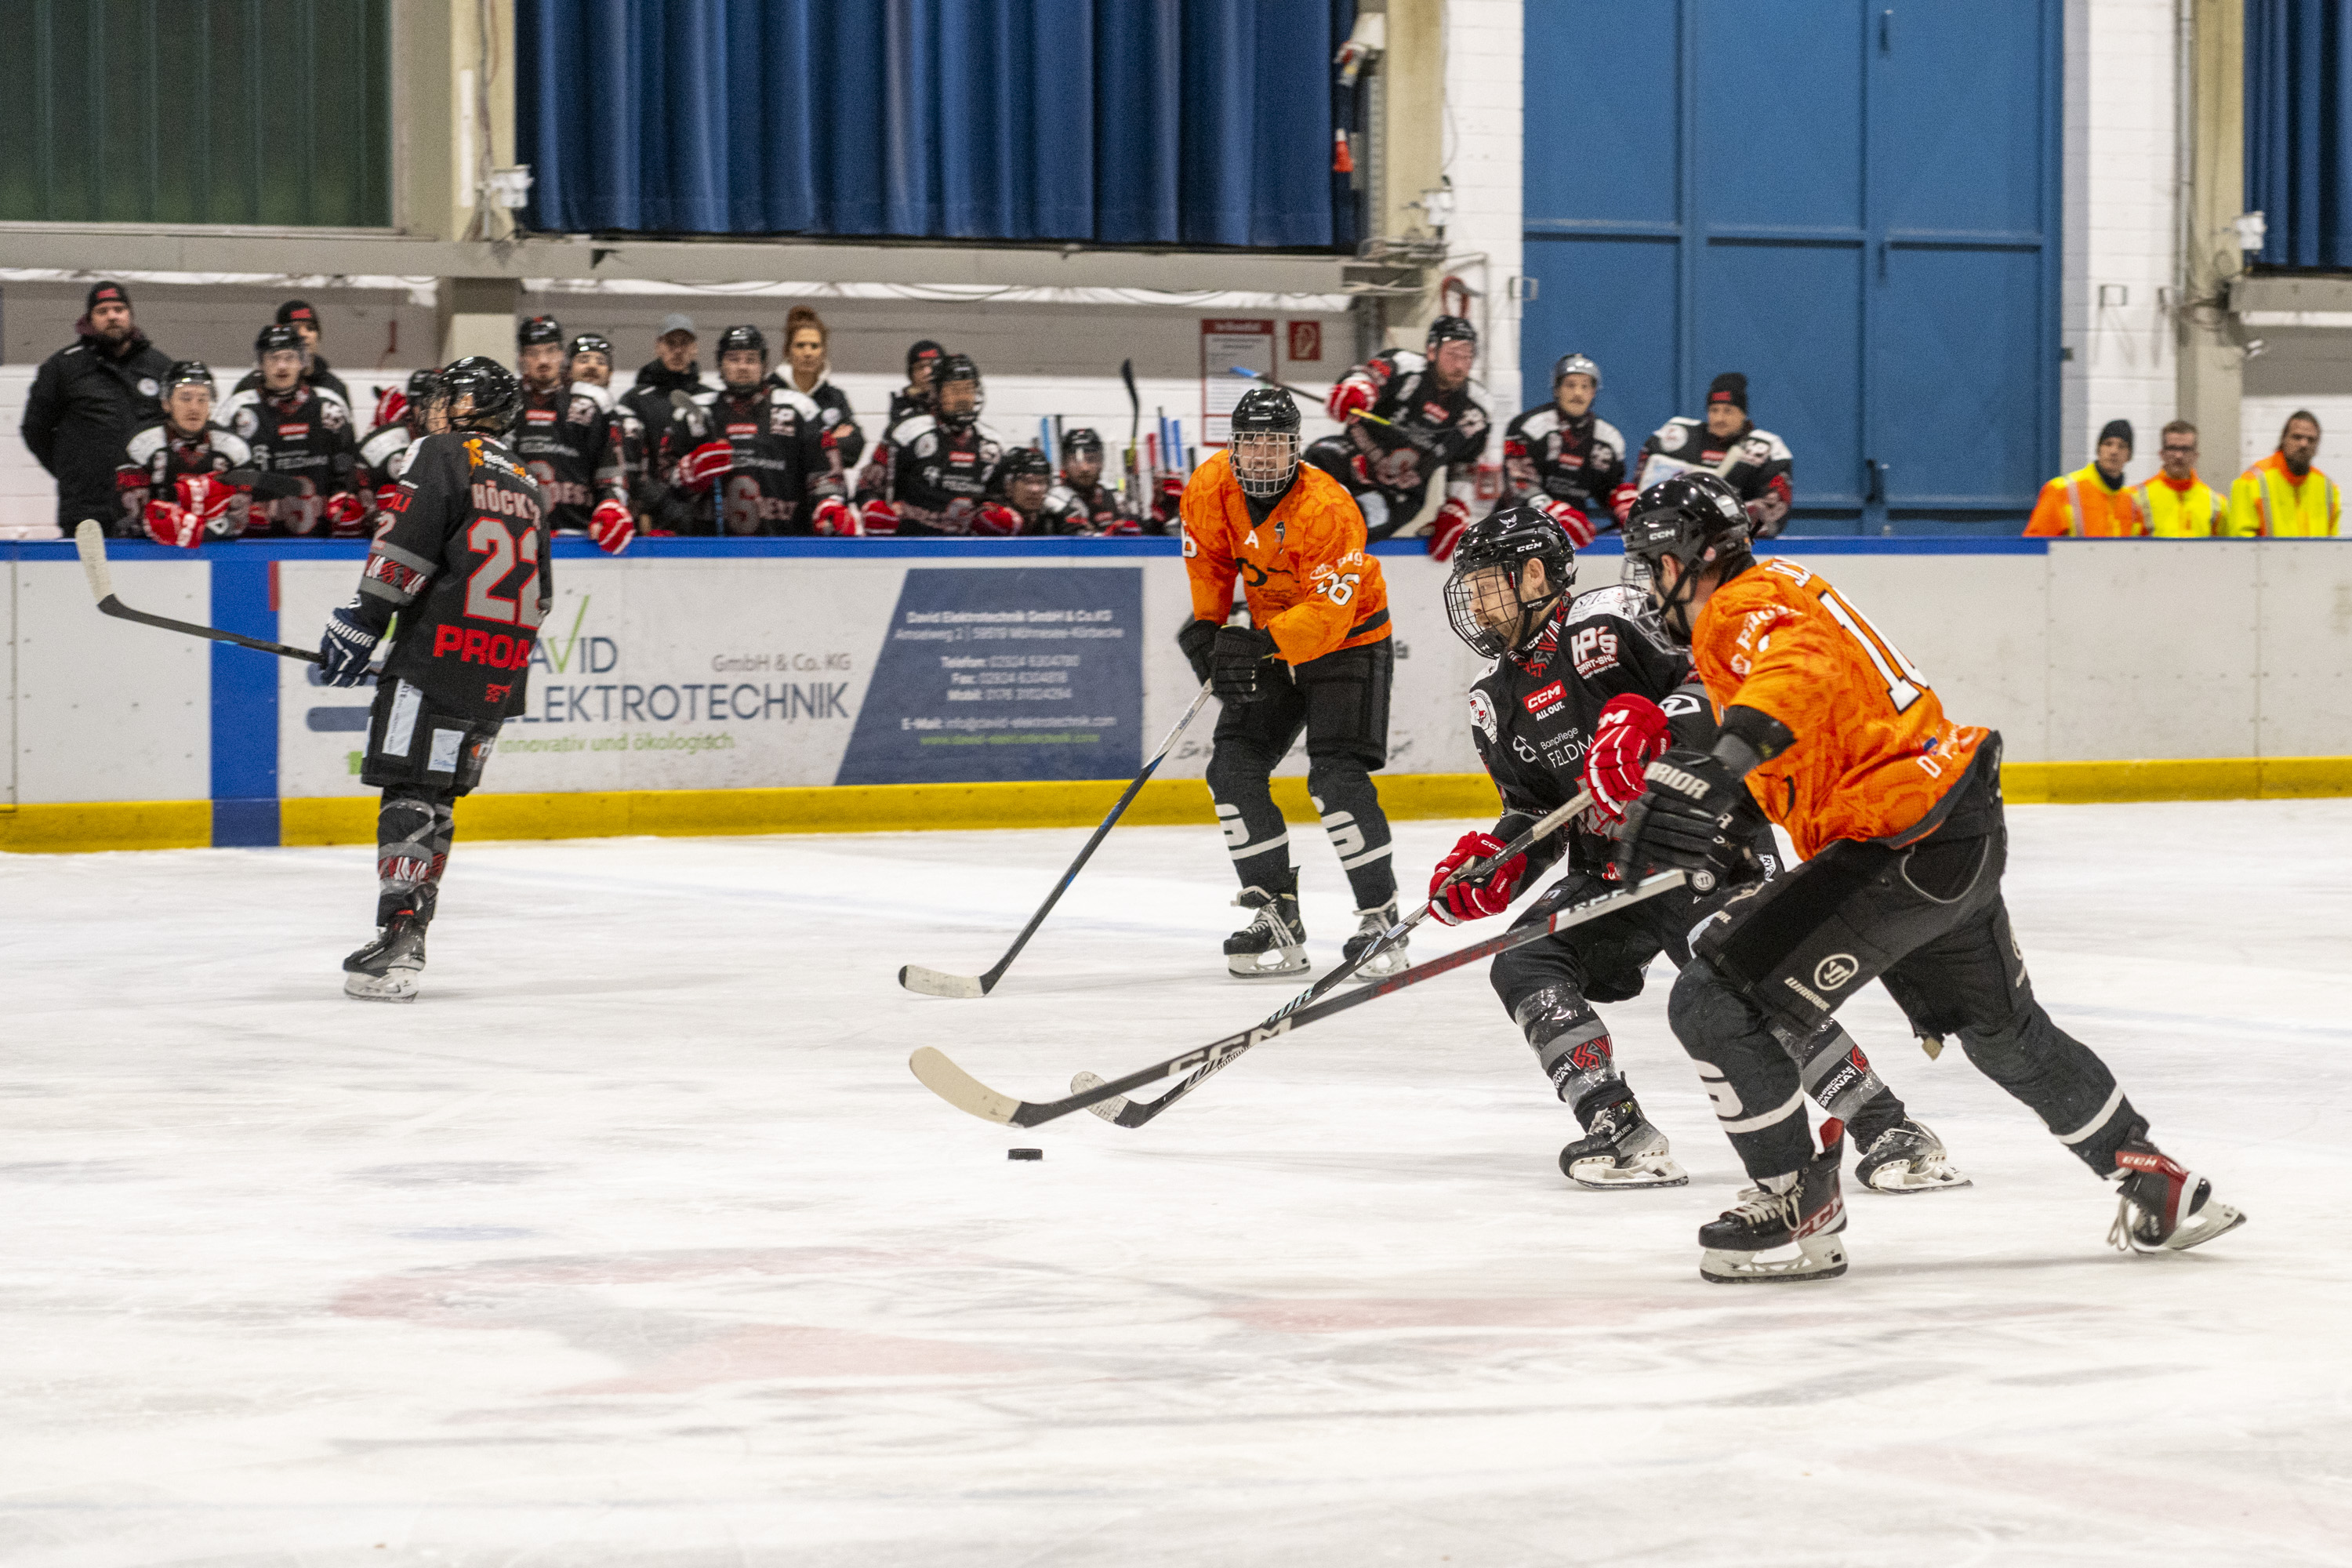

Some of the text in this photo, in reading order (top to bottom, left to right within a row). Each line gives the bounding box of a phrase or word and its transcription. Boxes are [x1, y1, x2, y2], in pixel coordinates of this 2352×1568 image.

[1244, 530, 1259, 549] A
[1650, 529, 1675, 540] CCM
[1517, 542, 1542, 552] CCM
[712, 652, 852, 672] GmbH & Co. KG
[504, 681, 850, 724] EKTROTECHNIK
[1528, 685, 1561, 709] CCM
[1536, 709, 1550, 721] ALL
[590, 732, 630, 751] und
[633, 731, 735, 754] ökologisch
[1784, 977, 1831, 1012] WARRIOR
[1169, 1017, 1292, 1076] CCM
[1817, 1065, 1853, 1104] FAHRSCHULE
[1612, 1123, 1633, 1143] BAUER
[2122, 1154, 2158, 1168] CCM
[1791, 1196, 1842, 1241] CCM
